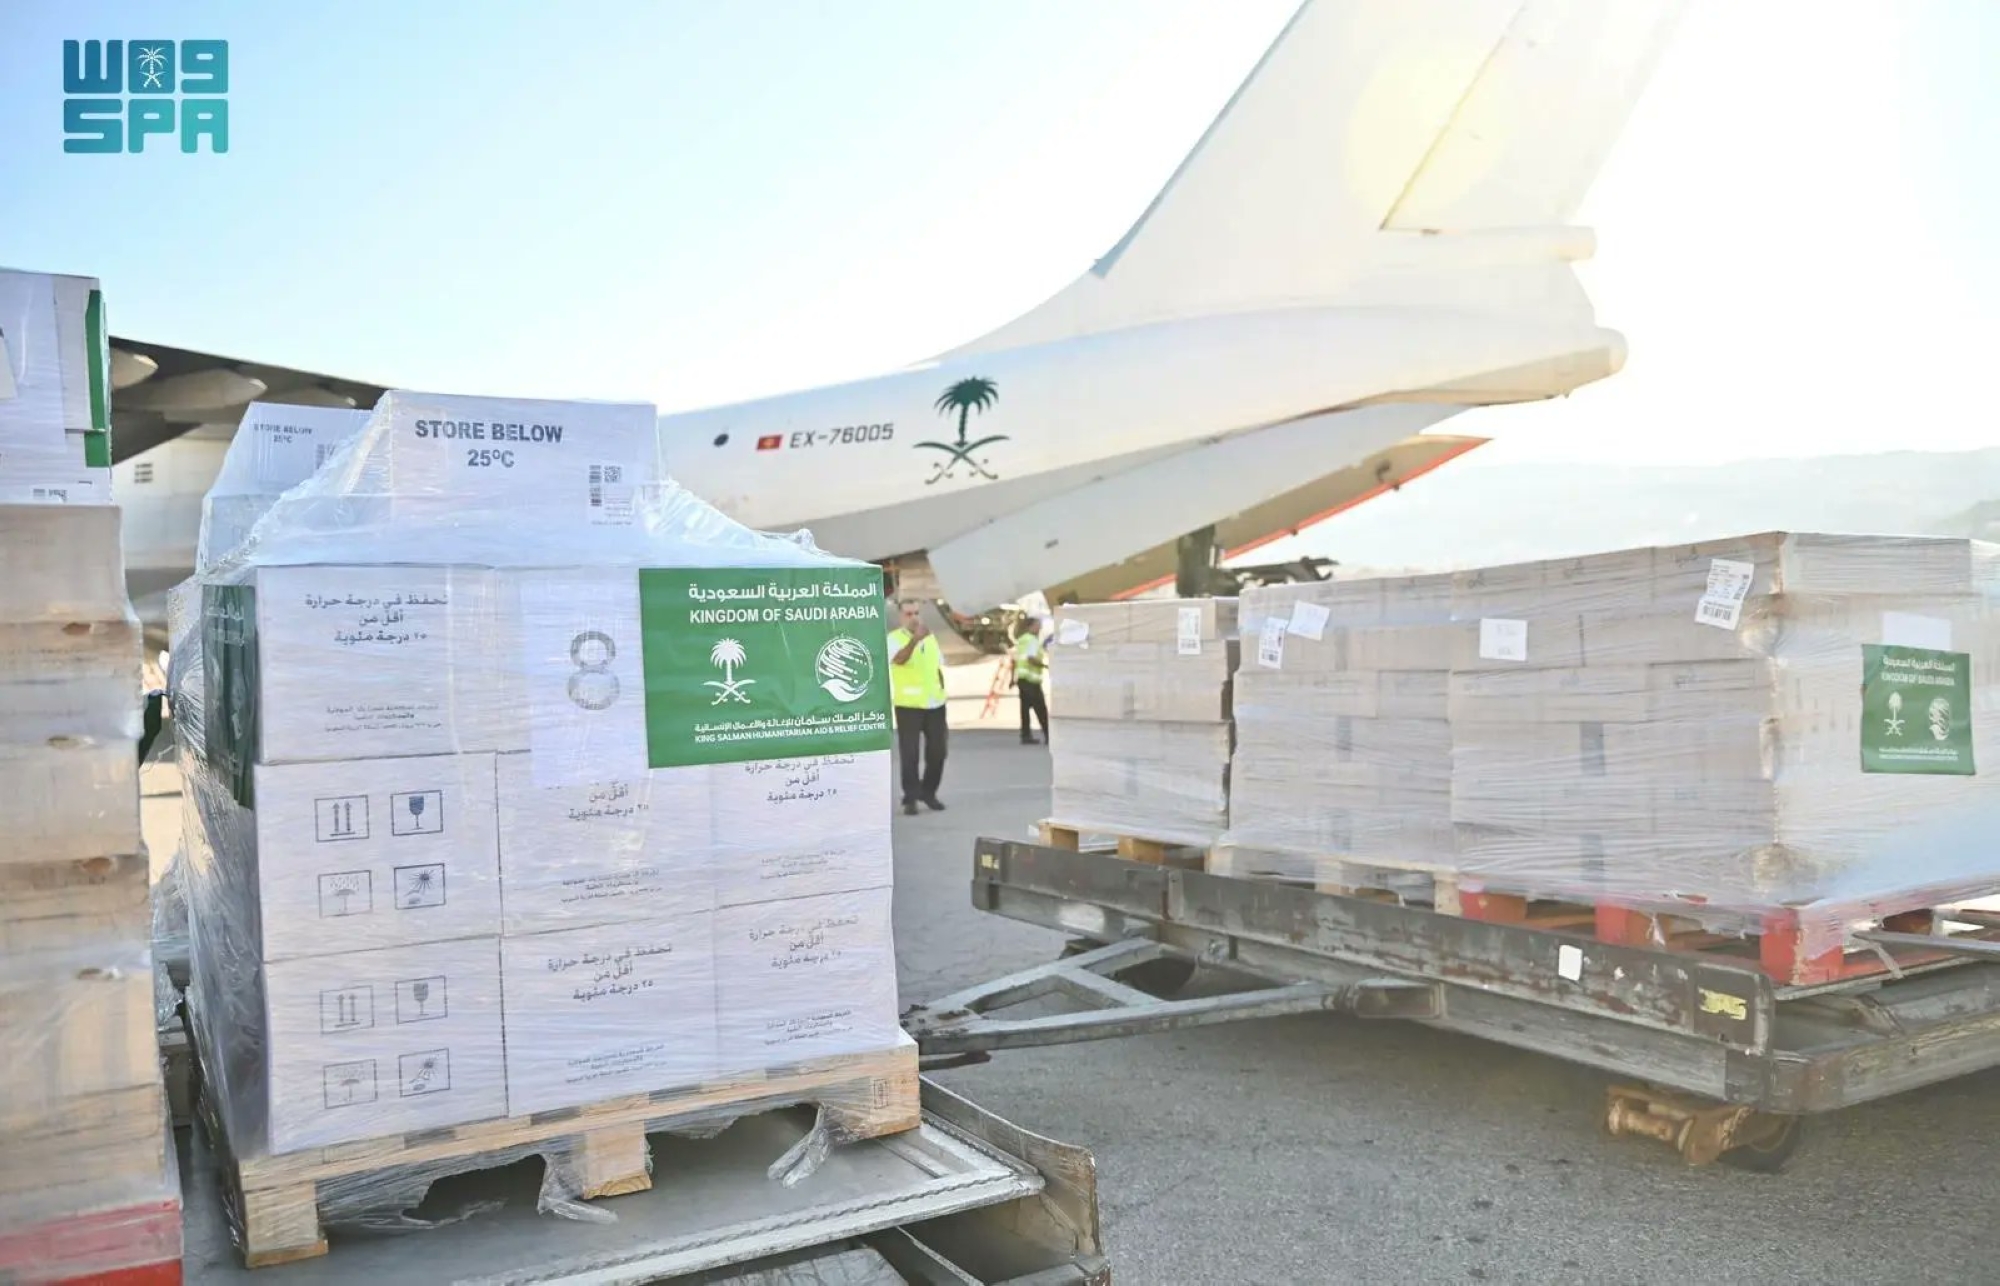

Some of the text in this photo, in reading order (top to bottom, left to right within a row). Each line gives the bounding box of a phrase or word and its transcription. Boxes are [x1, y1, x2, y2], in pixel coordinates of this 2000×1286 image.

[415, 420, 564, 443] STORE BELOW
[790, 423, 894, 449] EX-76005
[689, 581, 877, 603] المملكة العربية السعودية
[304, 594, 342, 609] حرارة
[345, 594, 380, 609] درجة
[690, 606, 879, 624] KINGDOM OF SAUDI ARABIA
[375, 630, 410, 645] درجة
[833, 713, 860, 724] الملك
[862, 712, 886, 722] مركز
[695, 732, 716, 743] KING
[717, 731, 752, 742] SALMAN
[752, 728, 813, 740] HUMANITARIAN
[834, 724, 857, 733] RELIEF
[609, 983, 639, 996] درجة
